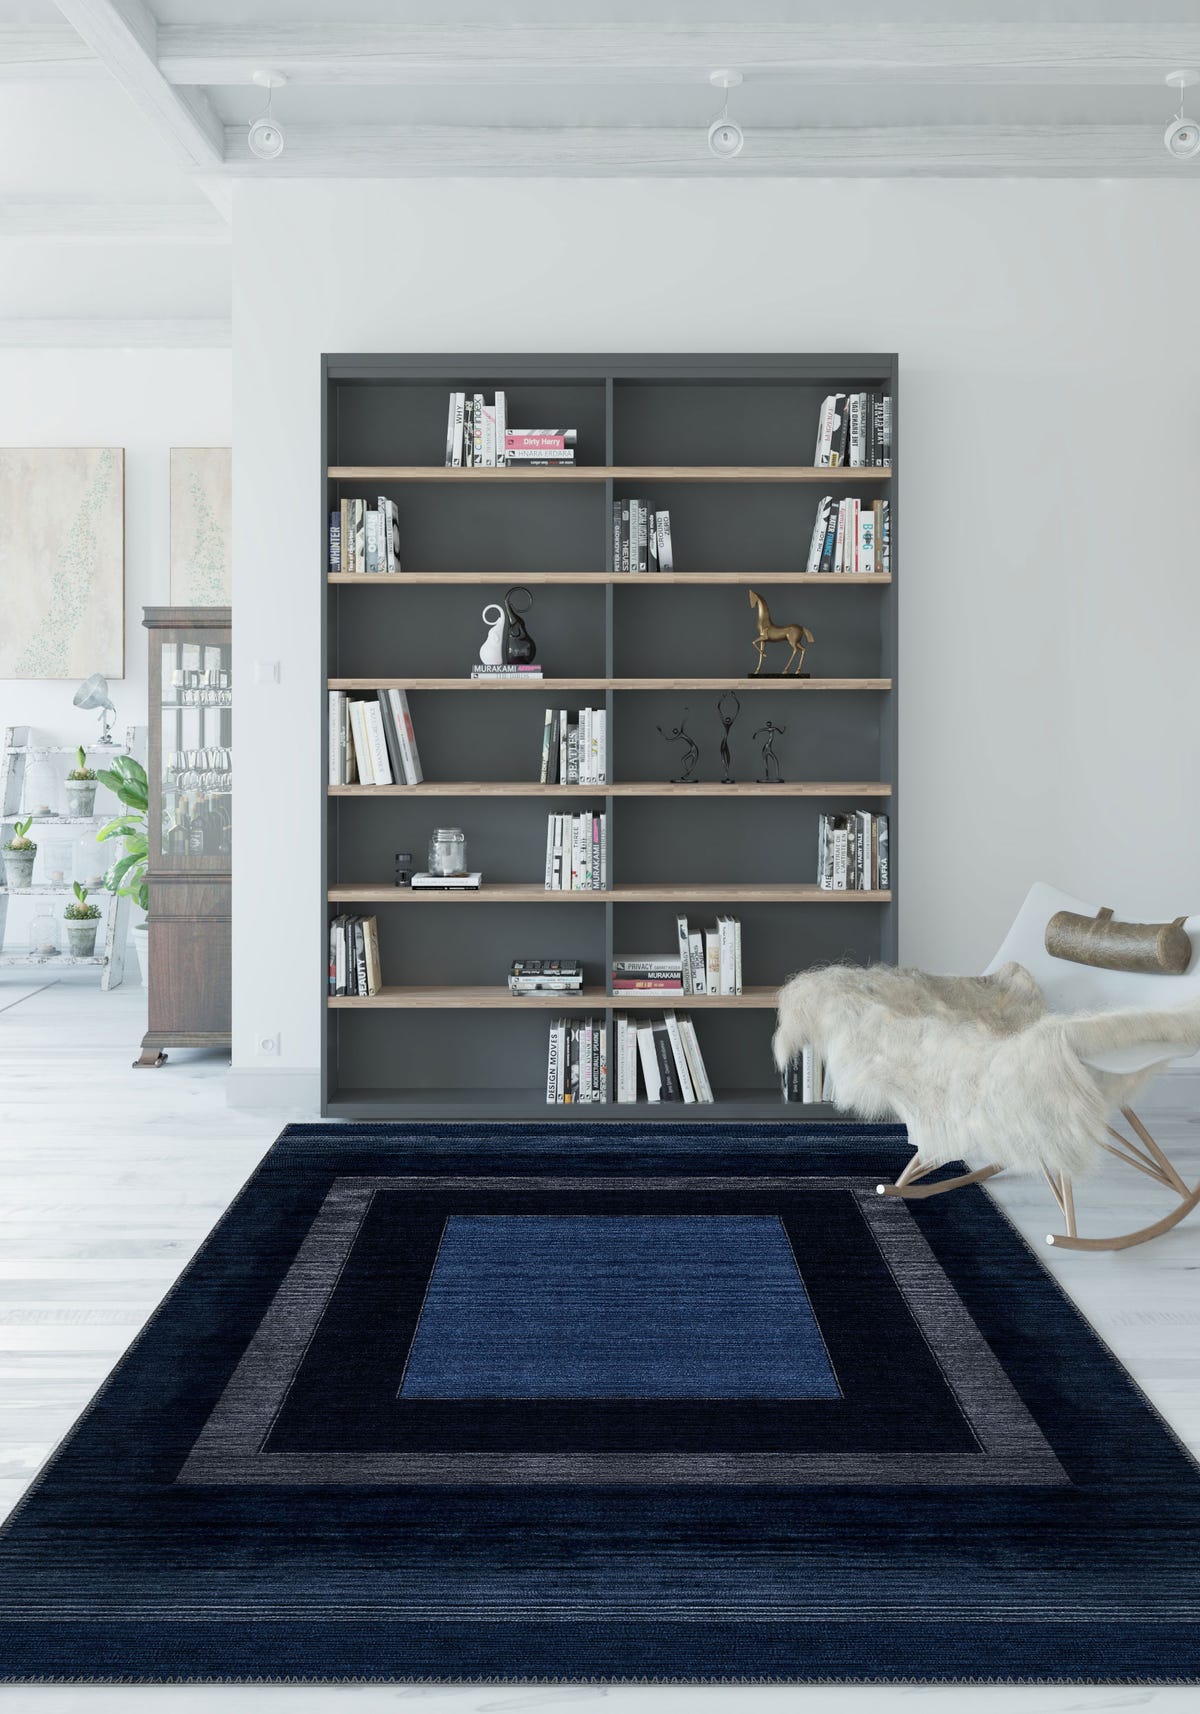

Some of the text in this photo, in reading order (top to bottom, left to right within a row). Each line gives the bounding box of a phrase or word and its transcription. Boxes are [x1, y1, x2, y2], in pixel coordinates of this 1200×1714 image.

[542, 438, 560, 446] Harry
[368, 515, 377, 553] OCEAN
[568, 733, 577, 780] BEATLES
[880, 858, 888, 884] KAFKA
[357, 959, 367, 996] BEAUTY
